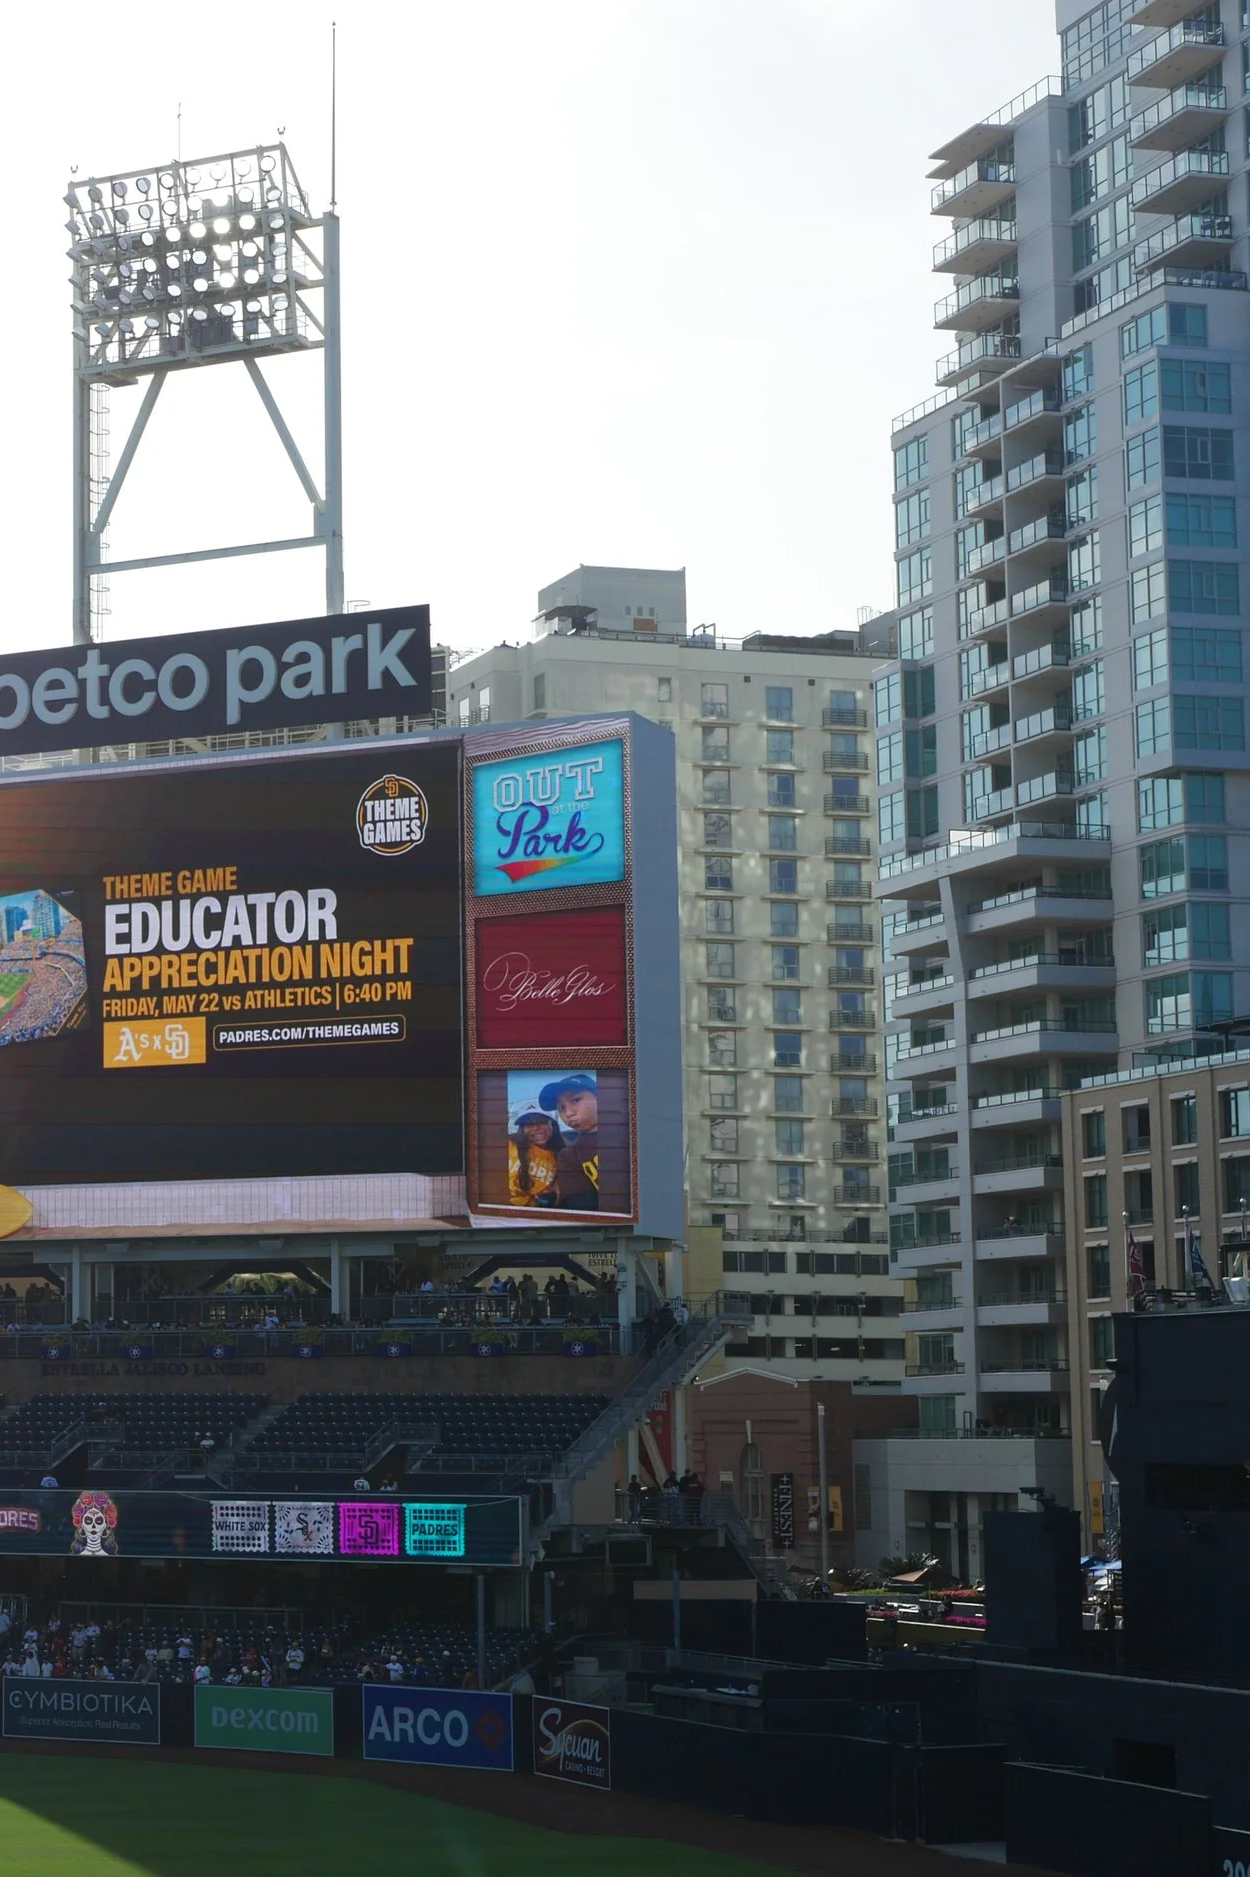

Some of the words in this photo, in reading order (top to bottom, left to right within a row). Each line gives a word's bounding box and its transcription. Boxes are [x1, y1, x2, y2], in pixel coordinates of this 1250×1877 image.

[226, 622, 418, 726] park
[493, 756, 604, 814] OUT
[364, 796, 420, 822] THEME
[551, 804, 565, 815] at
[568, 800, 590, 812] the
[363, 819, 421, 845] GAMES
[496, 801, 604, 859] Park
[103, 871, 172, 901] THEME
[177, 866, 238, 895] GAME
[104, 888, 338, 956] EDUCATOR
[102, 944, 313, 993] APPRECIATION
[319, 937, 414, 980] NIGHT
[102, 996, 159, 1018] FRIDAY,
[162, 994, 197, 1014] MAY
[199, 992, 220, 1013] 22
[244, 986, 332, 1010] ATHLETICS
[343, 982, 382, 1003] 6:40
[385, 981, 412, 1001] PM
[552, 964, 617, 1006] Glos
[219, 1022, 400, 1044] PADRES.COM/THEMEGAMES
[41, 1362, 120, 1376] ESTRELLA
[123, 1362, 189, 1376] JALISCO
[214, 1520, 246, 1532] WHITE
[248, 1521, 266, 1532] SOX
[778, 1484, 794, 1541] FINEST
[412, 1524, 458, 1537] PADRES
[8, 1690, 154, 1716] CYMBIOTIKA
[19, 1715, 51, 1727] Superior
[95, 1719, 112, 1729] Real
[367, 1704, 469, 1748] ARCO
[538, 1707, 602, 1773] Sycuan
[565, 1760, 584, 1774] CASINO
[586, 1764, 606, 1777] RESORT
